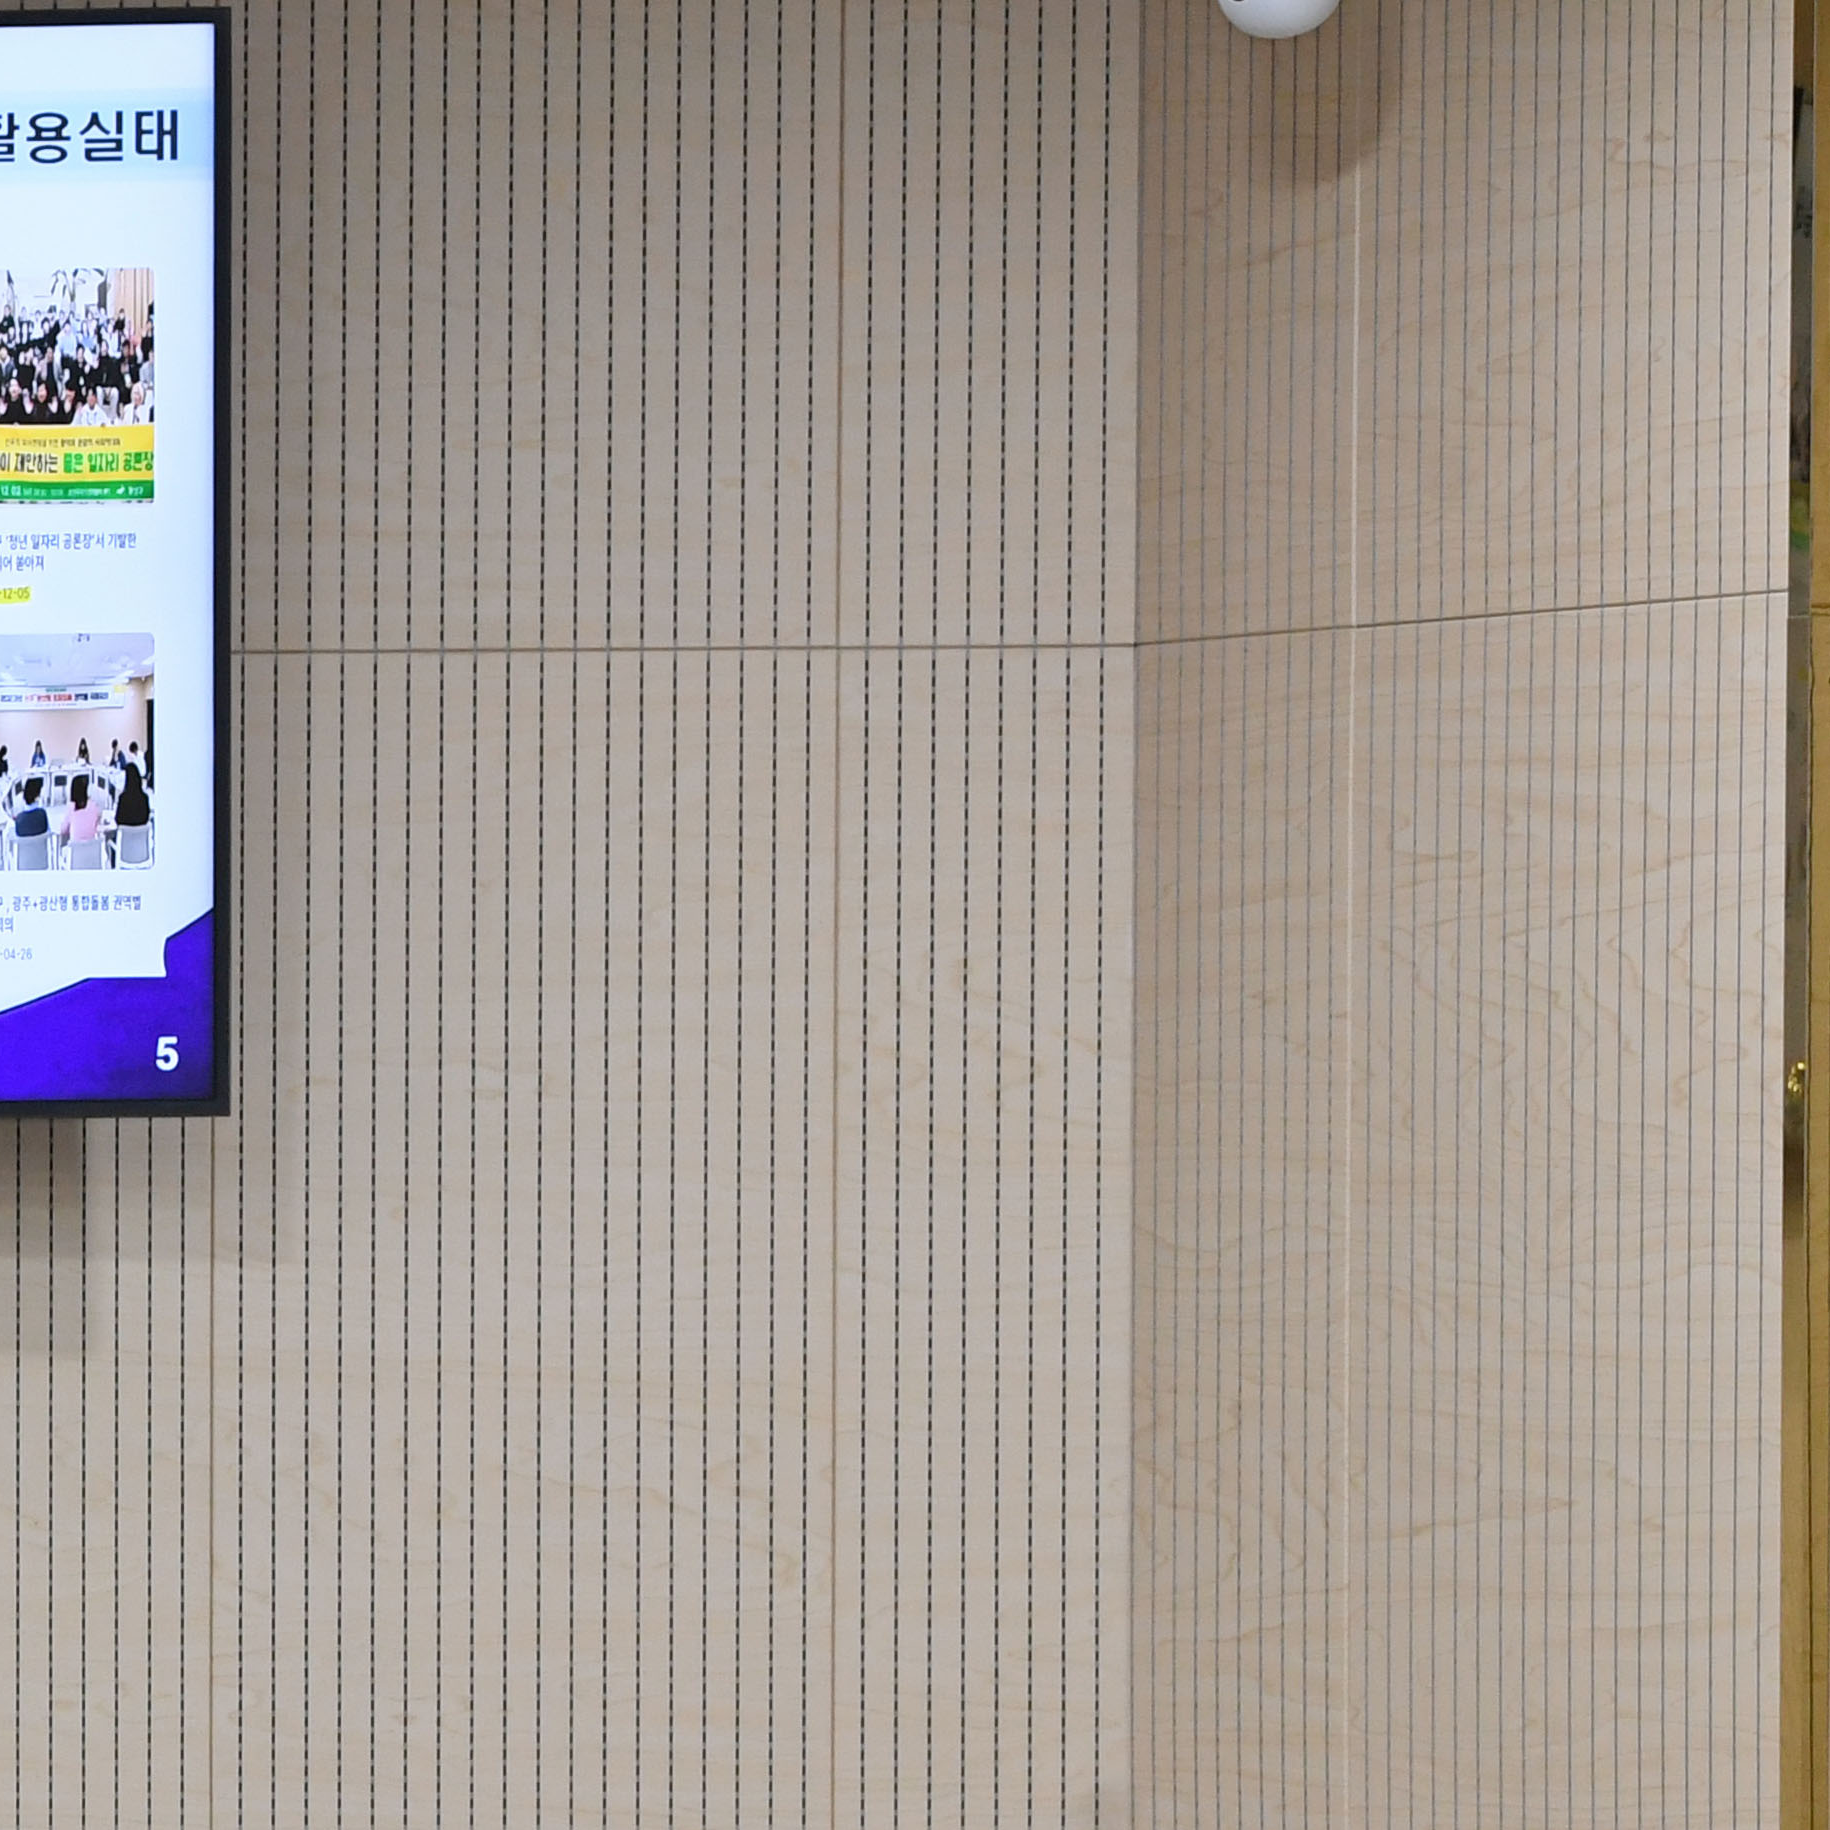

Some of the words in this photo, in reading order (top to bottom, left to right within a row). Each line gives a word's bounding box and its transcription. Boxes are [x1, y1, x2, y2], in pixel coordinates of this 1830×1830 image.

[88, 452, 120, 473] 일자리
[31, 534, 60, 550] 일자리
[108, 532, 137, 549] 기발한
[155, 1035, 180, 1072] 5
